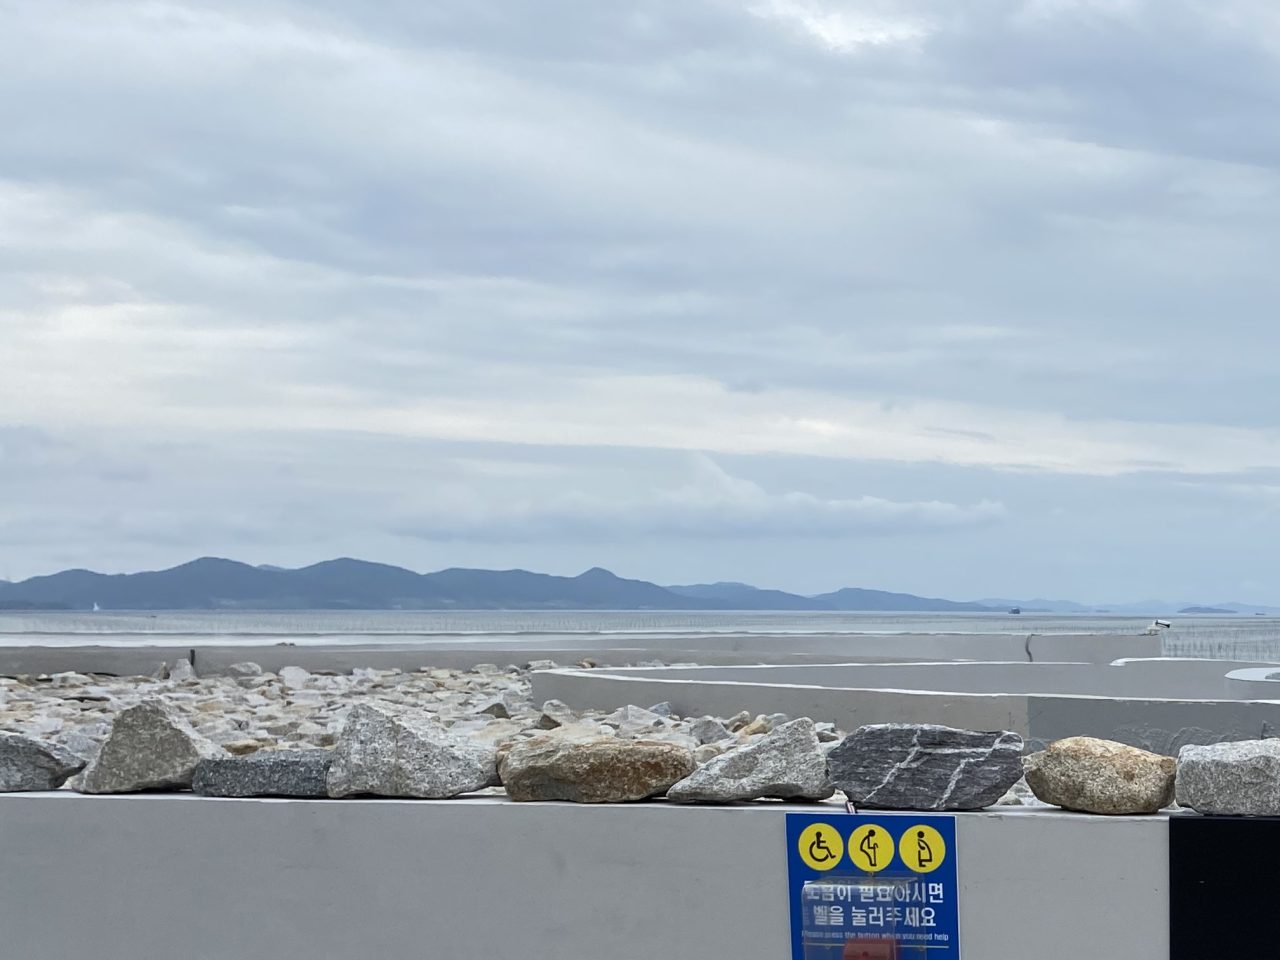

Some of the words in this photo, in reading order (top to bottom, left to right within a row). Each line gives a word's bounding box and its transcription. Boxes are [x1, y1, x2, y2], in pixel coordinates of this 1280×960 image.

[813, 905, 844, 926] 벨을
[852, 906, 937, 927] 눌러주세요
[934, 933, 949, 942] help
